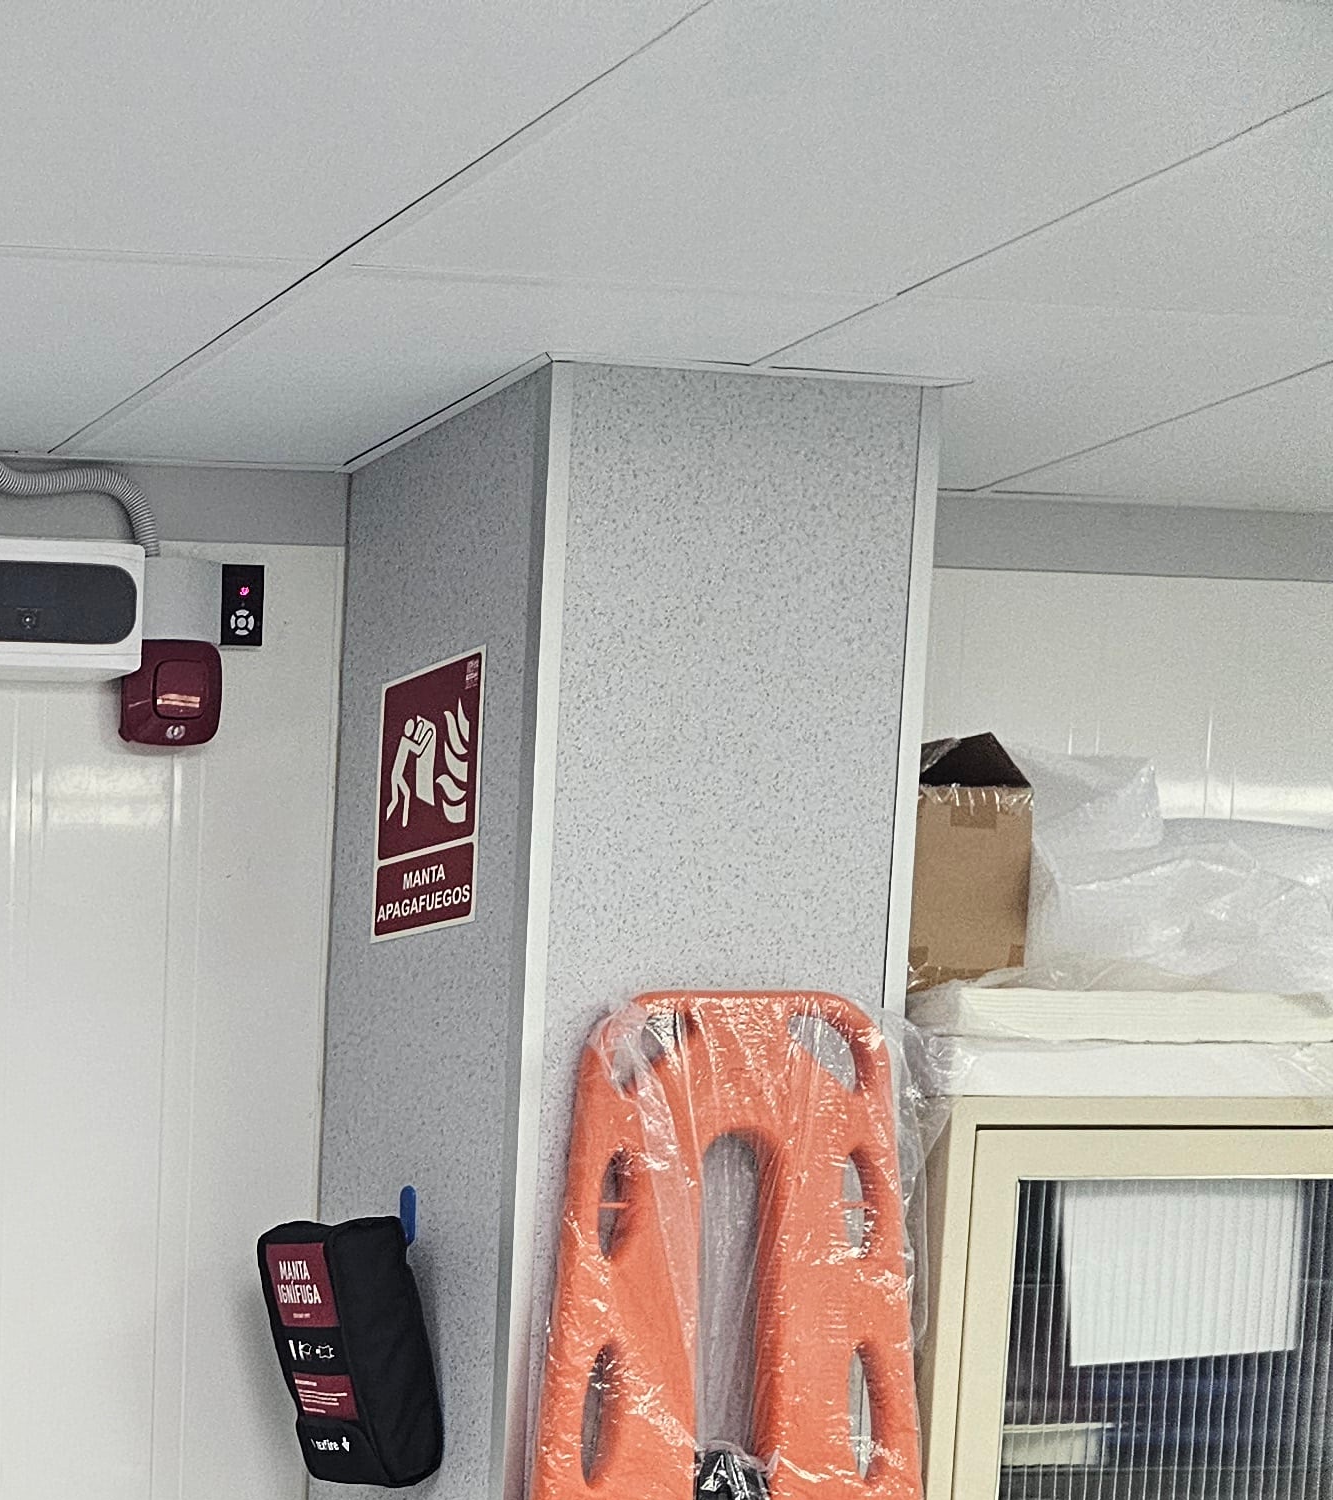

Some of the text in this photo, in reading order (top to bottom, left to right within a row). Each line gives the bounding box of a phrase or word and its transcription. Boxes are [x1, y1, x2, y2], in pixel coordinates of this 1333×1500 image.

[402, 863, 446, 890] MANTA
[376, 884, 471, 923] APAGAFUEGOS
[278, 1260, 311, 1281] MANTA
[276, 1280, 323, 1304] IGNÍFUGA
